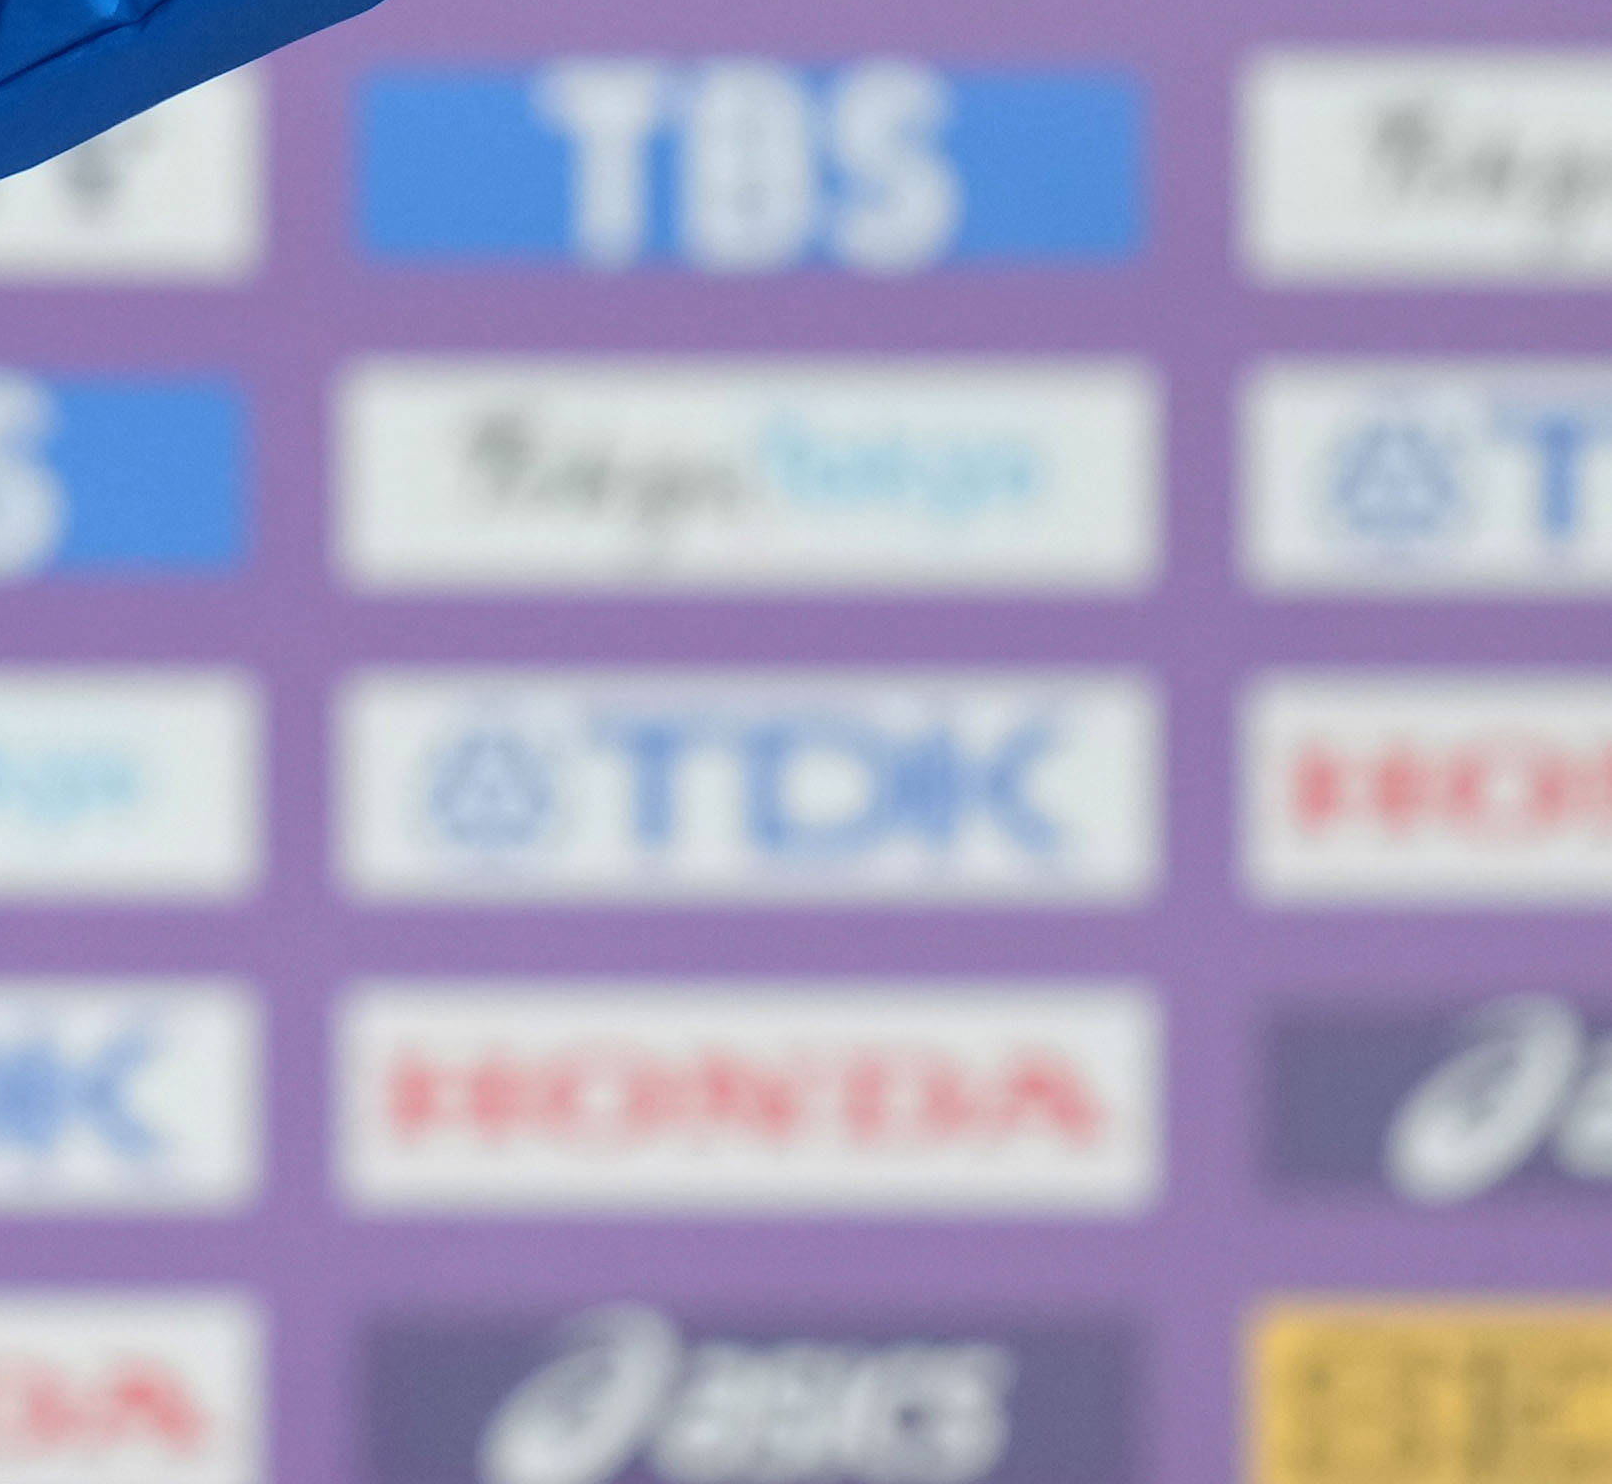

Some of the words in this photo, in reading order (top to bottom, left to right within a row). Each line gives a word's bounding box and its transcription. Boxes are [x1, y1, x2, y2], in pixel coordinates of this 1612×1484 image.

[537, 63, 964, 270] TBS
[600, 724, 1075, 862] TDK
[387, 1051, 1109, 1144] HONDA
